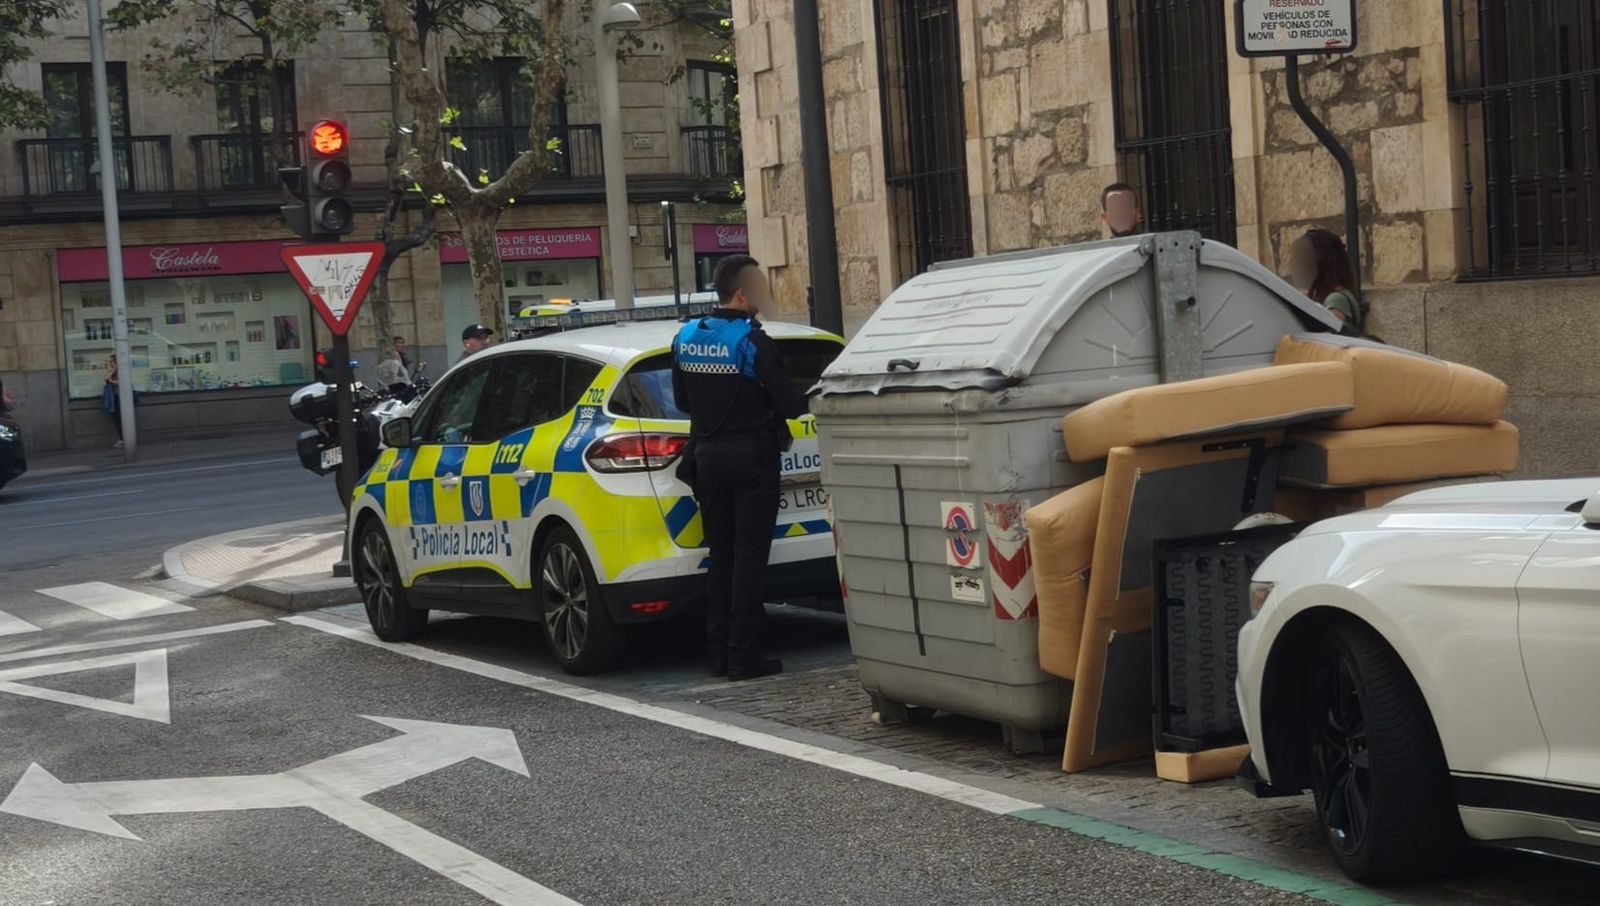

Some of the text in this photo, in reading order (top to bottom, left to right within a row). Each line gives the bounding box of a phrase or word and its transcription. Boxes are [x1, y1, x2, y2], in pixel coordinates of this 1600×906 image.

[1263, 10, 1331, 20] VEHÍCULOS DE
[1313, 20, 1333, 28] CON
[1301, 29, 1347, 39] REDUCIDA
[512, 235, 526, 245] DE
[528, 232, 592, 244] PELUQUERÍA
[150, 247, 219, 270] Castela
[679, 342, 729, 358] POLICÍA
[586, 388, 605, 403] 702
[501, 443, 523, 463] 112
[794, 488, 826, 508] LRC
[421, 524, 498, 556] Policía Local
